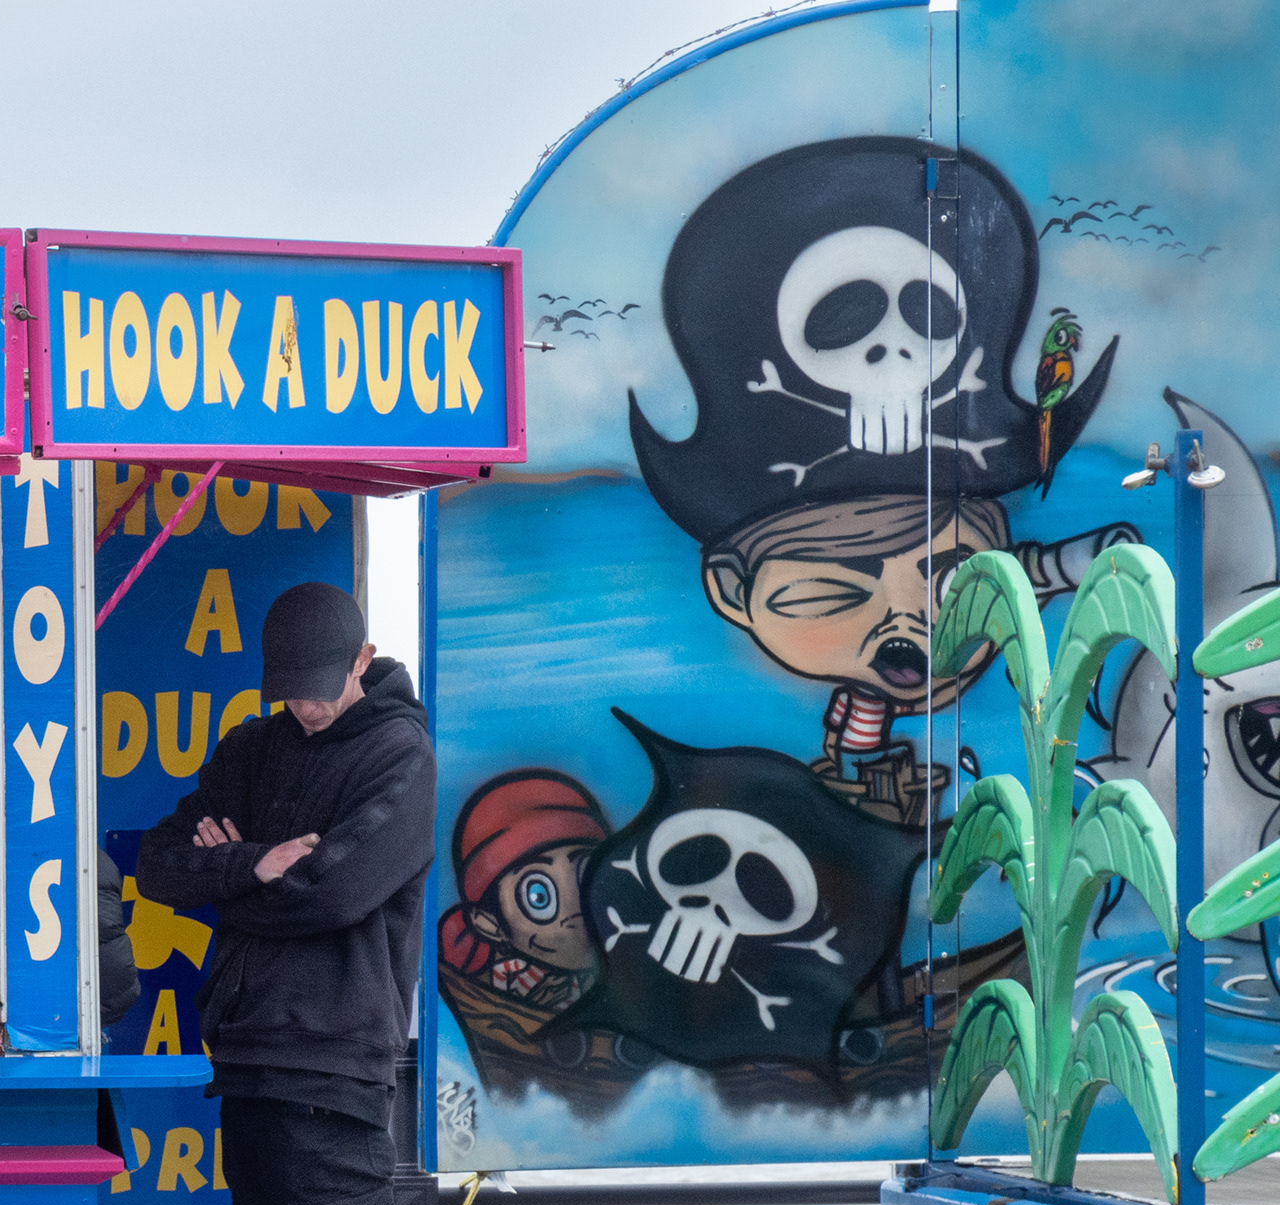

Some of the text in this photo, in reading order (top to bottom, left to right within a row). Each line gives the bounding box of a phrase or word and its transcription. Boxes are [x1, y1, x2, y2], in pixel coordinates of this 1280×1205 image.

[62, 289, 483, 414] HOOK A DUCK
[185, 568, 243, 657] A
[12, 458, 70, 962] TOYS
[143, 988, 182, 1056] A
[109, 1126, 230, 1195] PRI
